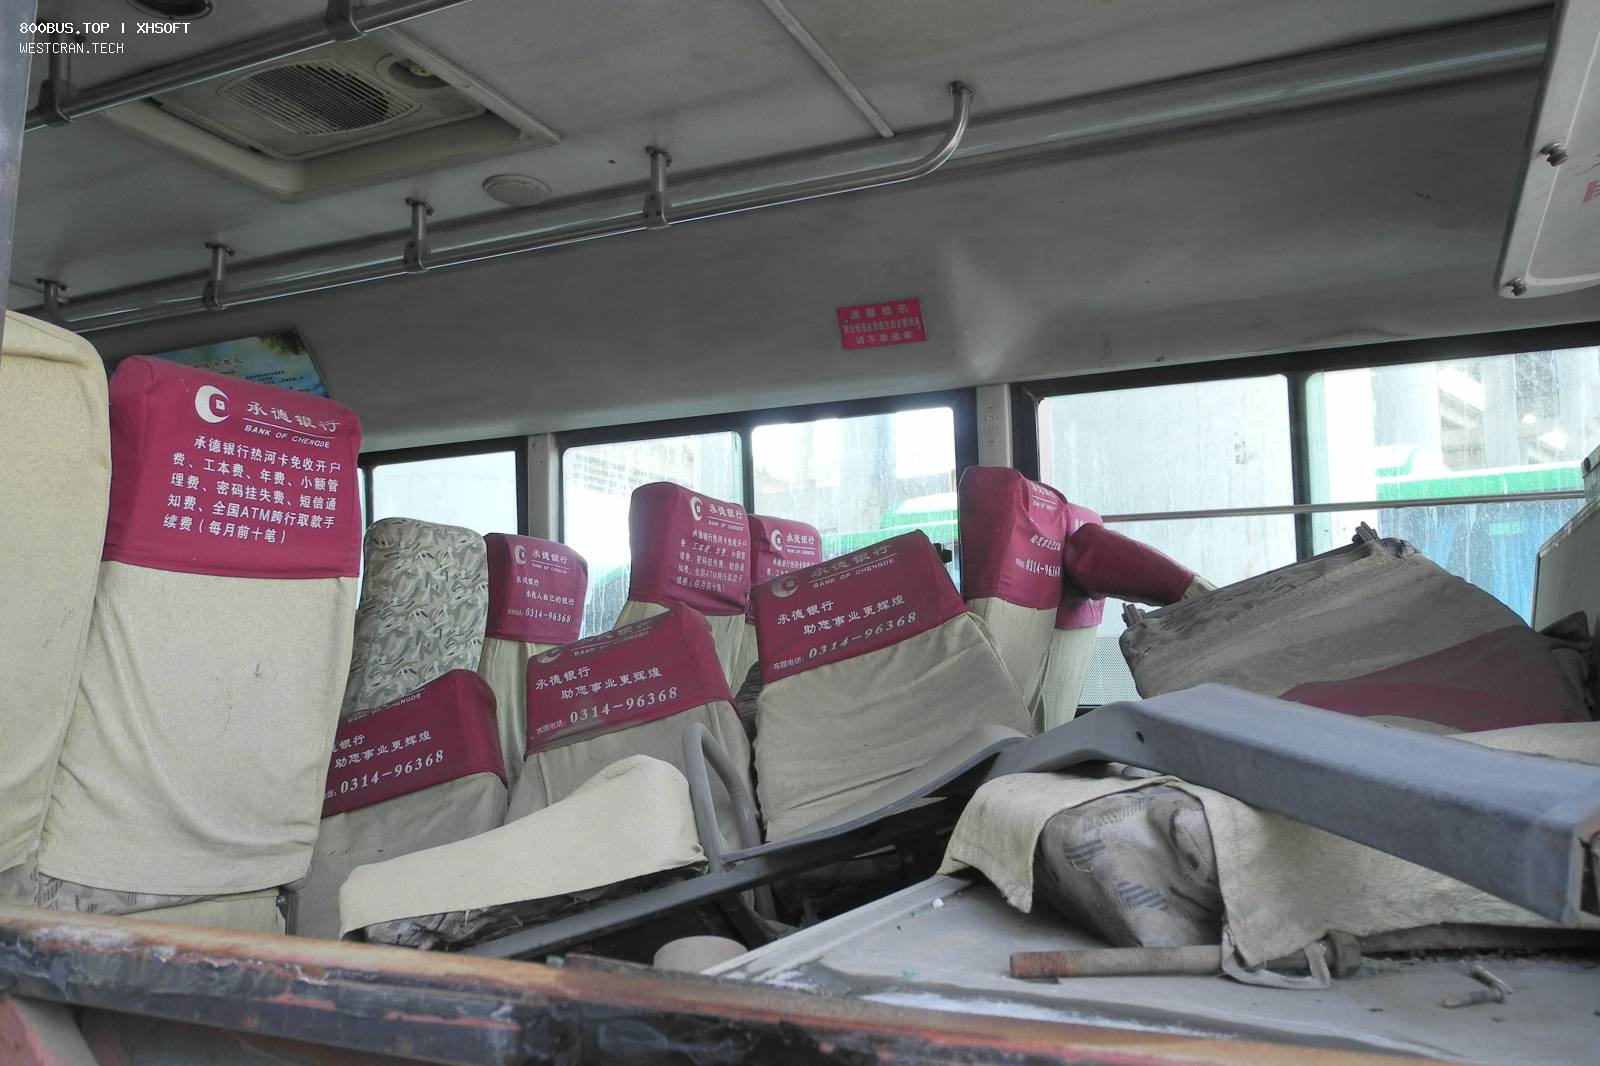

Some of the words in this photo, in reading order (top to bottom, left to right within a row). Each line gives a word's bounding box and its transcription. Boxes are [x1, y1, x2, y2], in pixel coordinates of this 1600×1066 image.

[247, 401, 341, 433] 承德银行
[194, 435, 341, 474] 承德银行热河卡免收开户
[244, 424, 271, 437] BANK
[275, 432, 288, 441] OF
[291, 435, 332, 449] CHENGDE
[173, 452, 340, 493] 费、工本费、年费、小额管
[171, 472, 338, 511] 理费、密码挂失费、短信通
[167, 494, 335, 530] 知费、全国ATM跨行取款手
[813, 578, 836, 589] BANK
[855, 558, 895, 576] CHENGDE
[777, 599, 834, 625] 承德银行
[803, 594, 905, 635] 助您事业更辉煌
[535, 666, 591, 691] 承德银行
[560, 666, 663, 700] 助您事业更辉煌
[570, 686, 678, 724] 0314-96368
[334, 730, 432, 769] 助您事业更辉煌
[340, 749, 444, 794] 0314-96368
